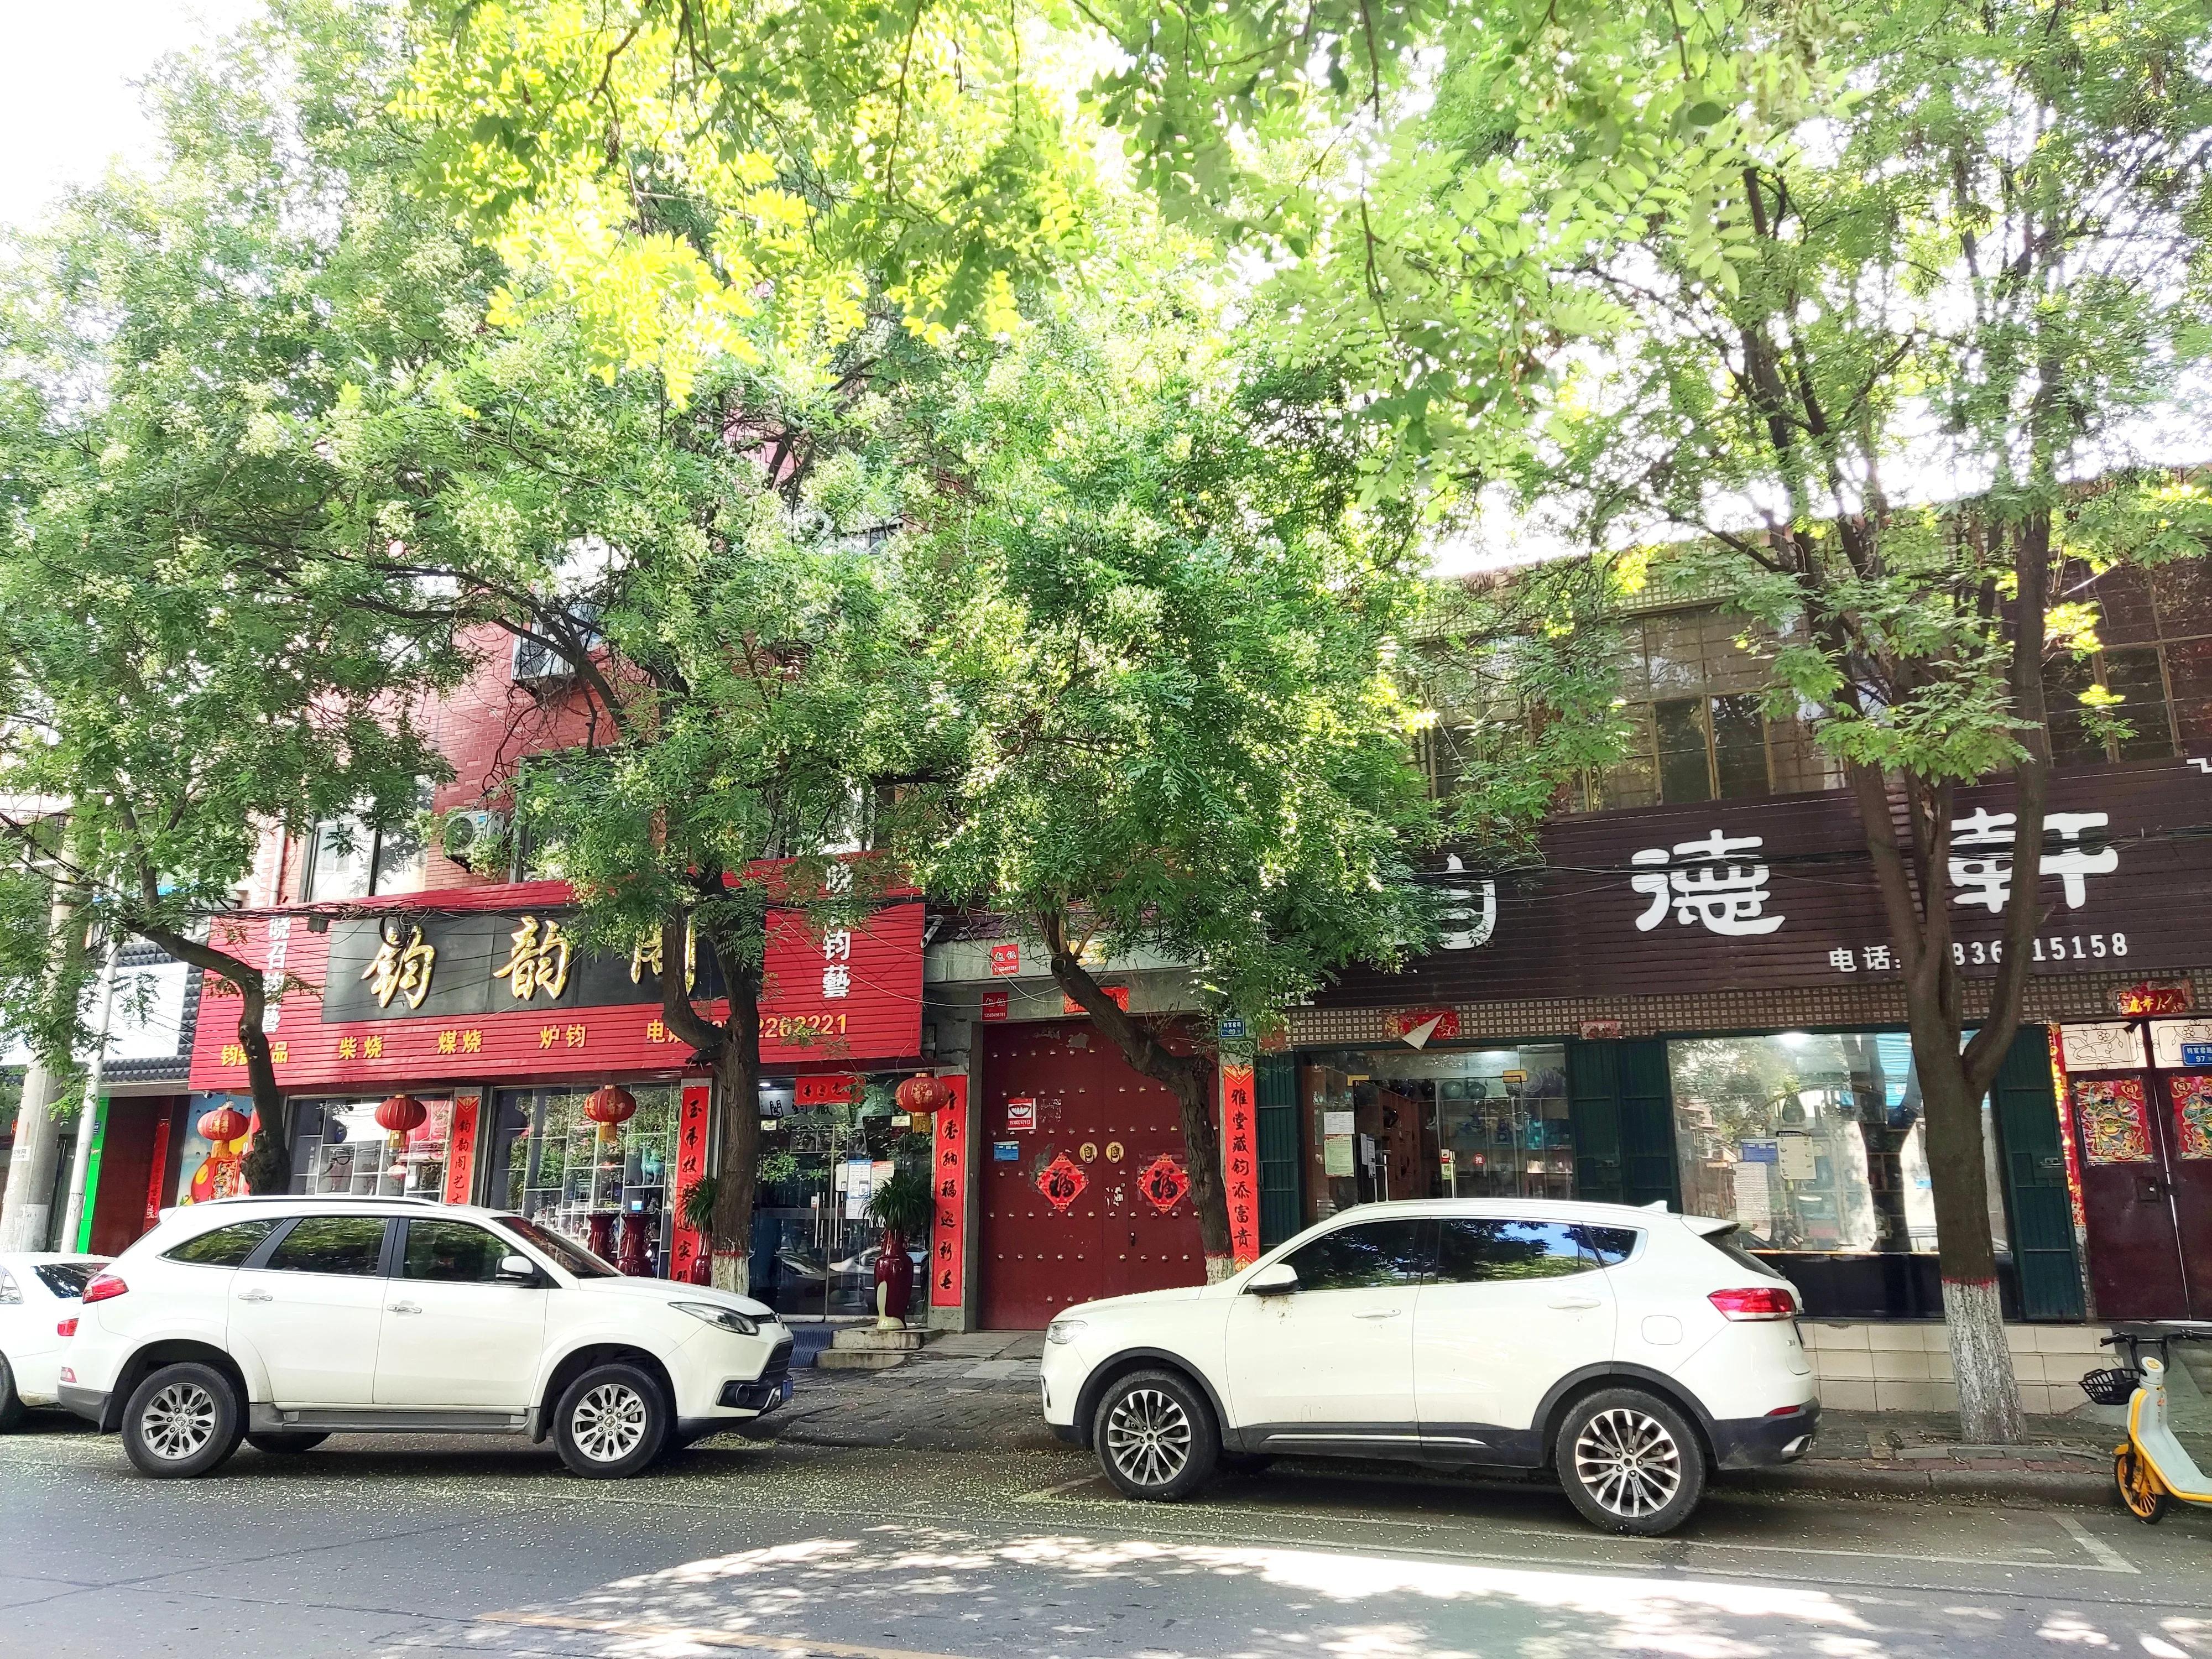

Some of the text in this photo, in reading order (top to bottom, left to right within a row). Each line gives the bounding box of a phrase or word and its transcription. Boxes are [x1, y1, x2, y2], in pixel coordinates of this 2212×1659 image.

[338, 1035, 383, 1060] 柴烧
[437, 1029, 482, 1054] 煤烧
[539, 1024, 586, 1049] 炉钧
[1231, 1088, 1253, 1248] 雅堂藏钧添富贵
